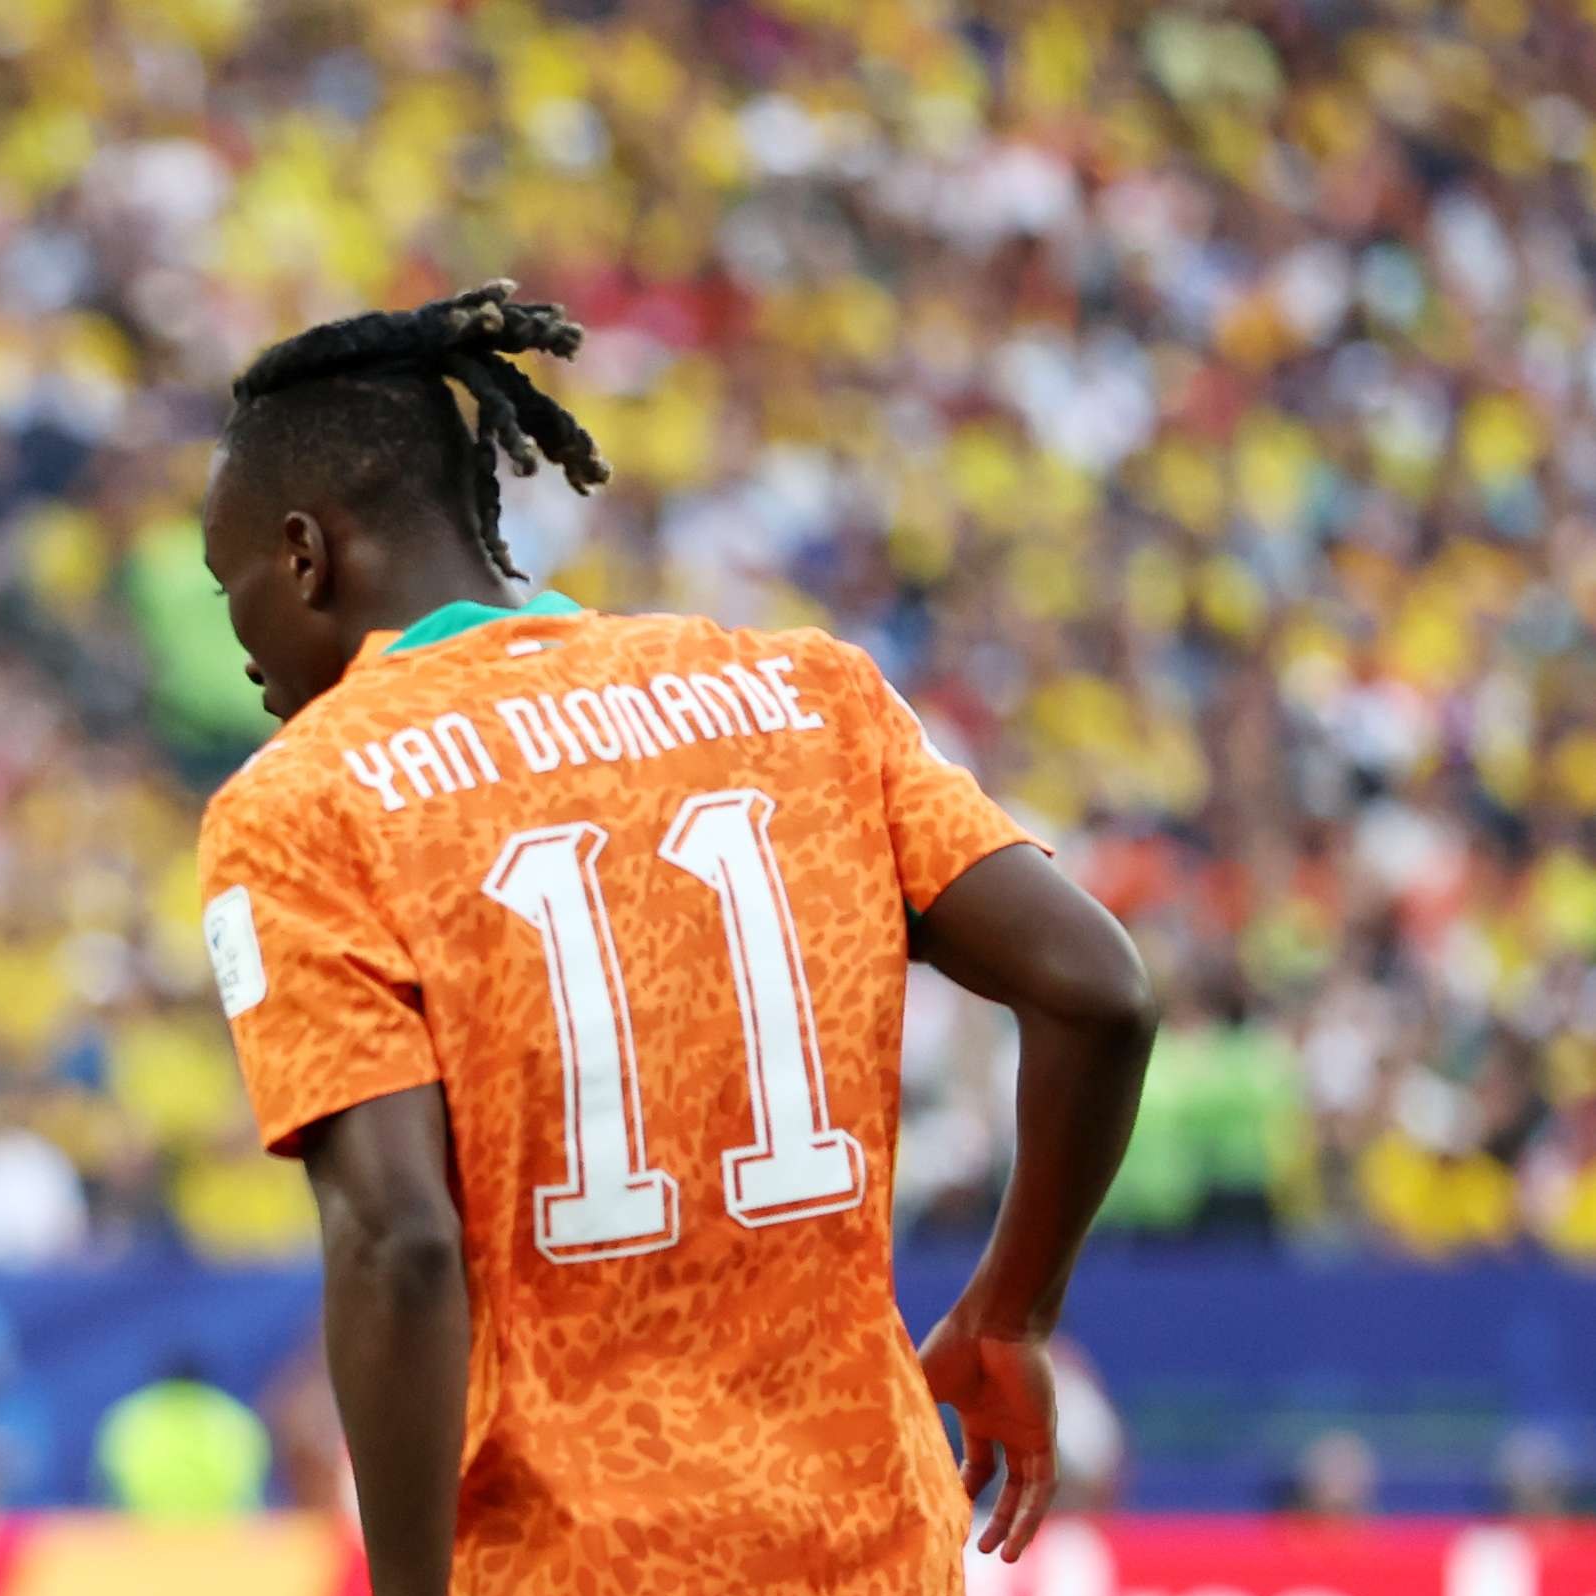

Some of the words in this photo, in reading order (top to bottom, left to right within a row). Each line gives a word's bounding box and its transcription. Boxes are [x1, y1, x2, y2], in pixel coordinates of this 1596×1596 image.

[342, 709, 501, 811] YAN
[499, 656, 826, 775] DIOMANDE
[482, 787, 867, 1266] 11
